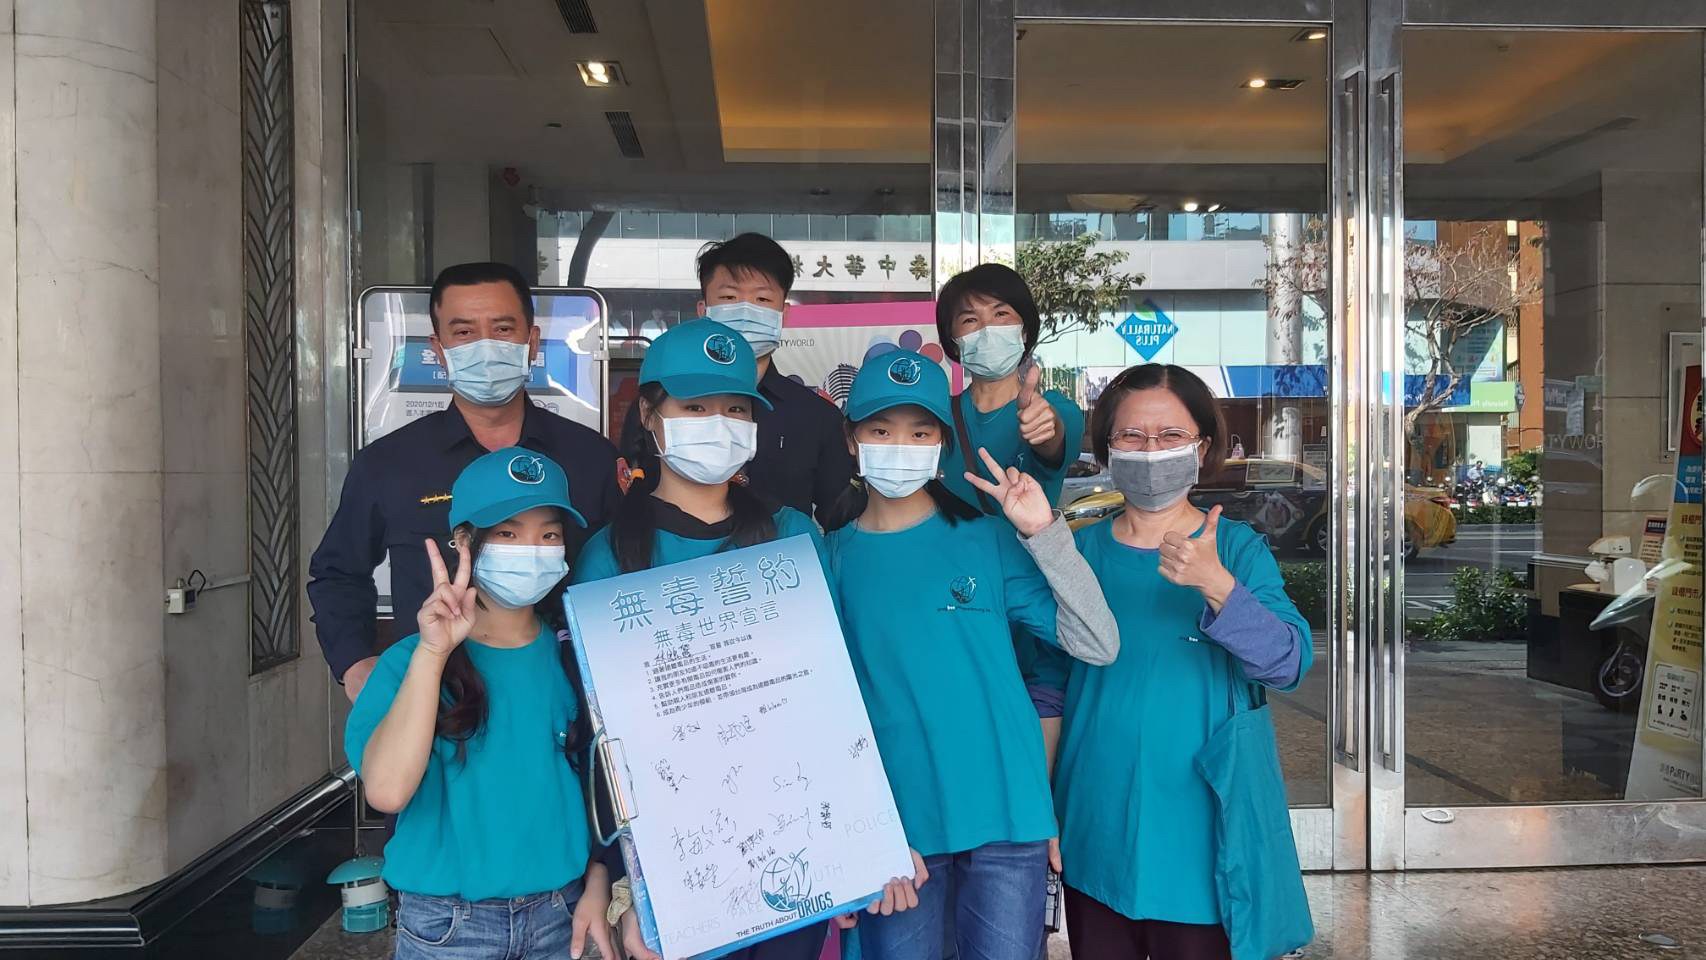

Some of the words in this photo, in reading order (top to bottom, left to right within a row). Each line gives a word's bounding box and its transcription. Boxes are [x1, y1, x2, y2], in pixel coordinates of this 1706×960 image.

[610, 552, 801, 633] 無毒誓約
[653, 600, 781, 649] 無毒世界宣言
[844, 807, 898, 839] POLICE
[736, 928, 750, 938] THE
[751, 921, 774, 933] TRUTH
[775, 911, 799, 925] ABOUT
[796, 891, 834, 919] DRUGS
